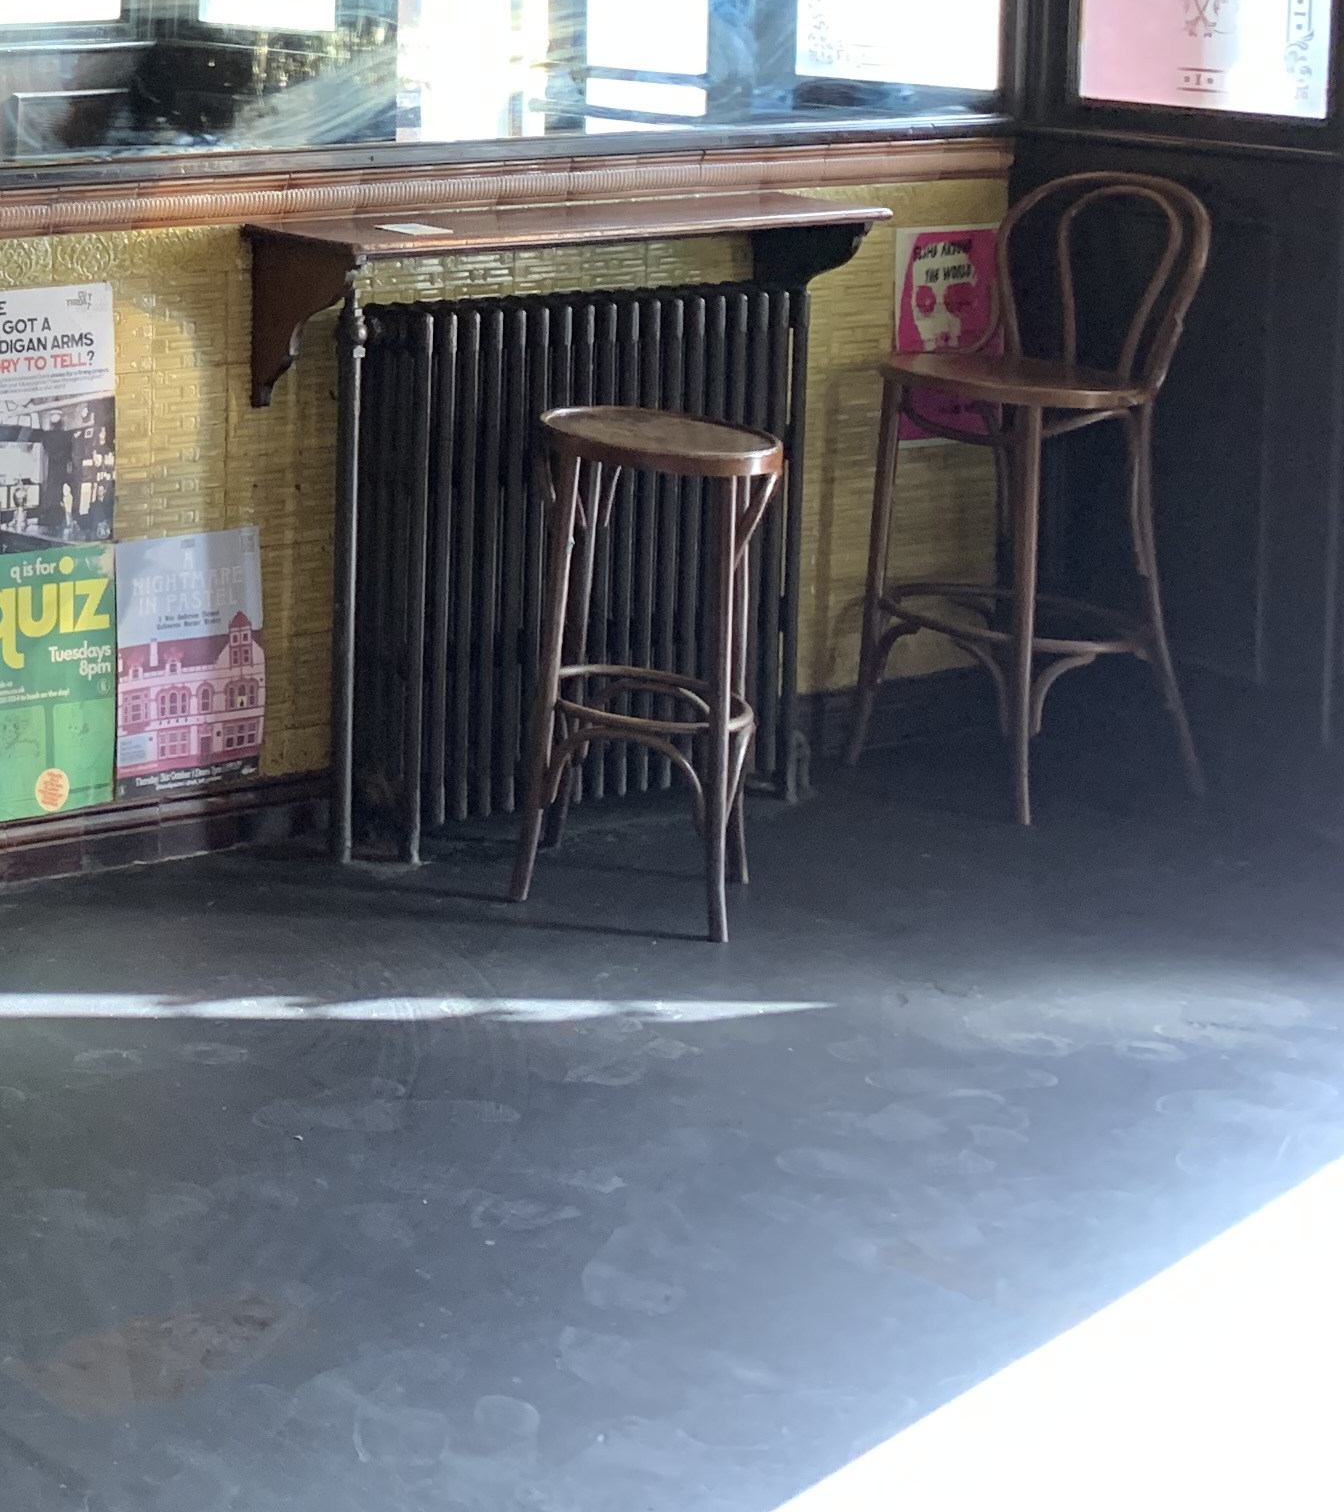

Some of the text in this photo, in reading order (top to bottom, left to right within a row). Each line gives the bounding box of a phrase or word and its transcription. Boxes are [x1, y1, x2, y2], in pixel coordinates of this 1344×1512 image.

[2, 318, 37, 334] GOT
[41, 317, 51, 331] A
[51, 333, 94, 350] ARMS
[24, 355, 47, 373] TO
[51, 350, 95, 370] TELL?
[11, 558, 56, 582] q is for
[183, 550, 194, 569] A
[132, 565, 243, 596] NIGHTMARE
[139, 588, 238, 616] IN PASTEL
[48, 641, 111, 664] Tuesdays
[79, 661, 111, 680] 8pm
